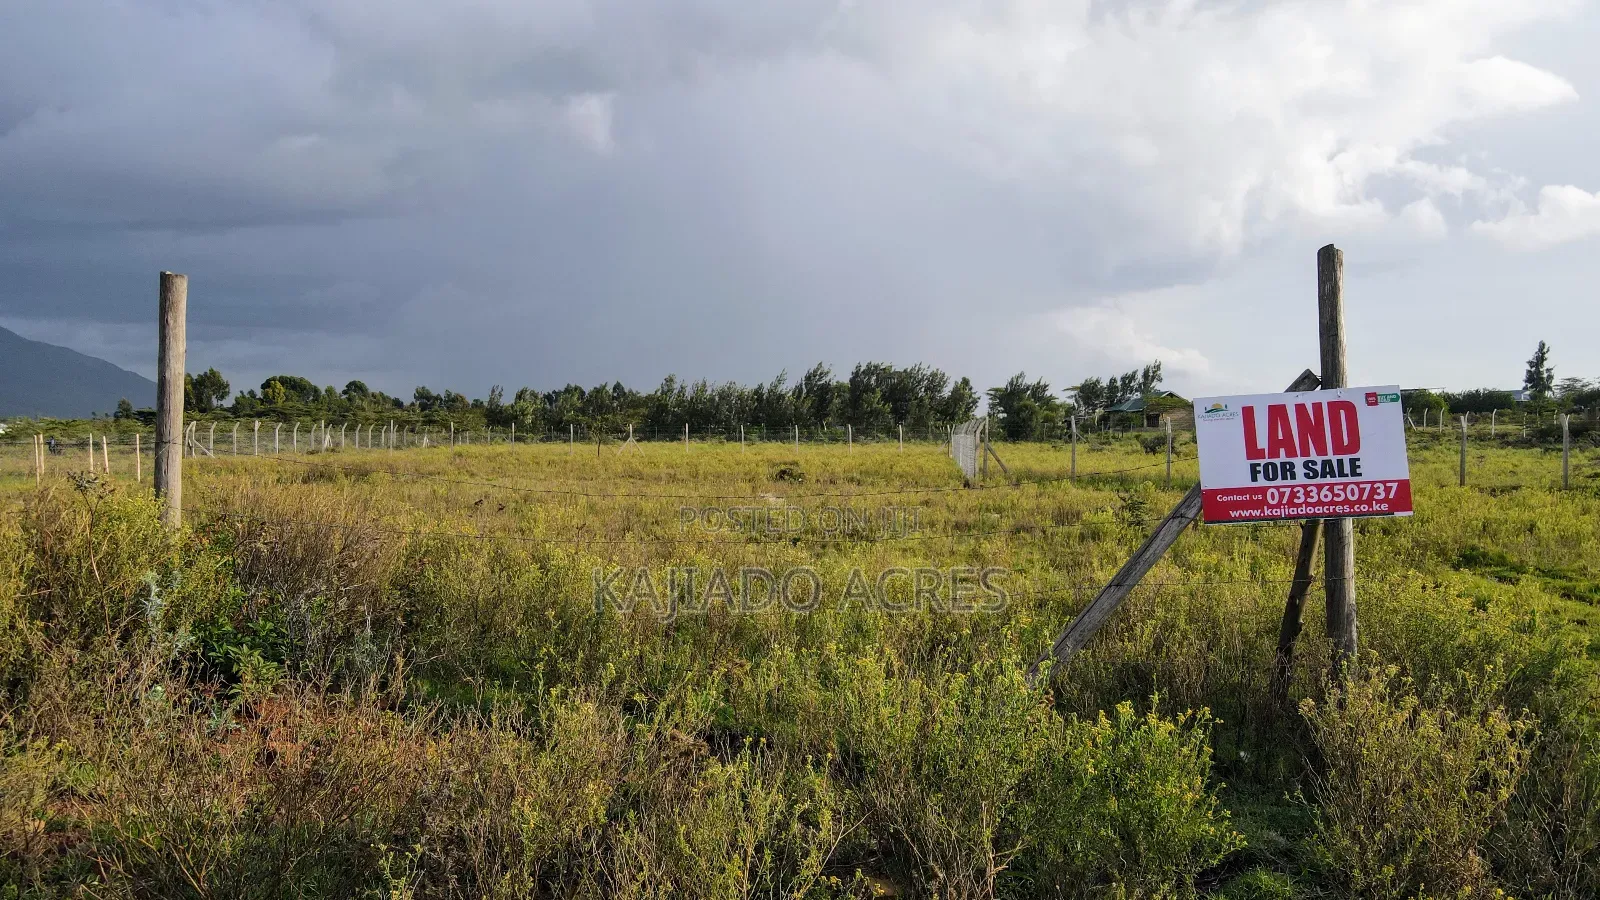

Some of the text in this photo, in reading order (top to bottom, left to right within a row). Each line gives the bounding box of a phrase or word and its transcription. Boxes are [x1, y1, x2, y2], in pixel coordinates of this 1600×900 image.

[1242, 400, 1360, 460] LAND
[1250, 458, 1362, 482] FOR SALE
[1216, 493, 1250, 502] Contact
[1266, 482, 1399, 505] 0733650737
[1229, 501, 1389, 518] www.kajiadoacres.co.ke
